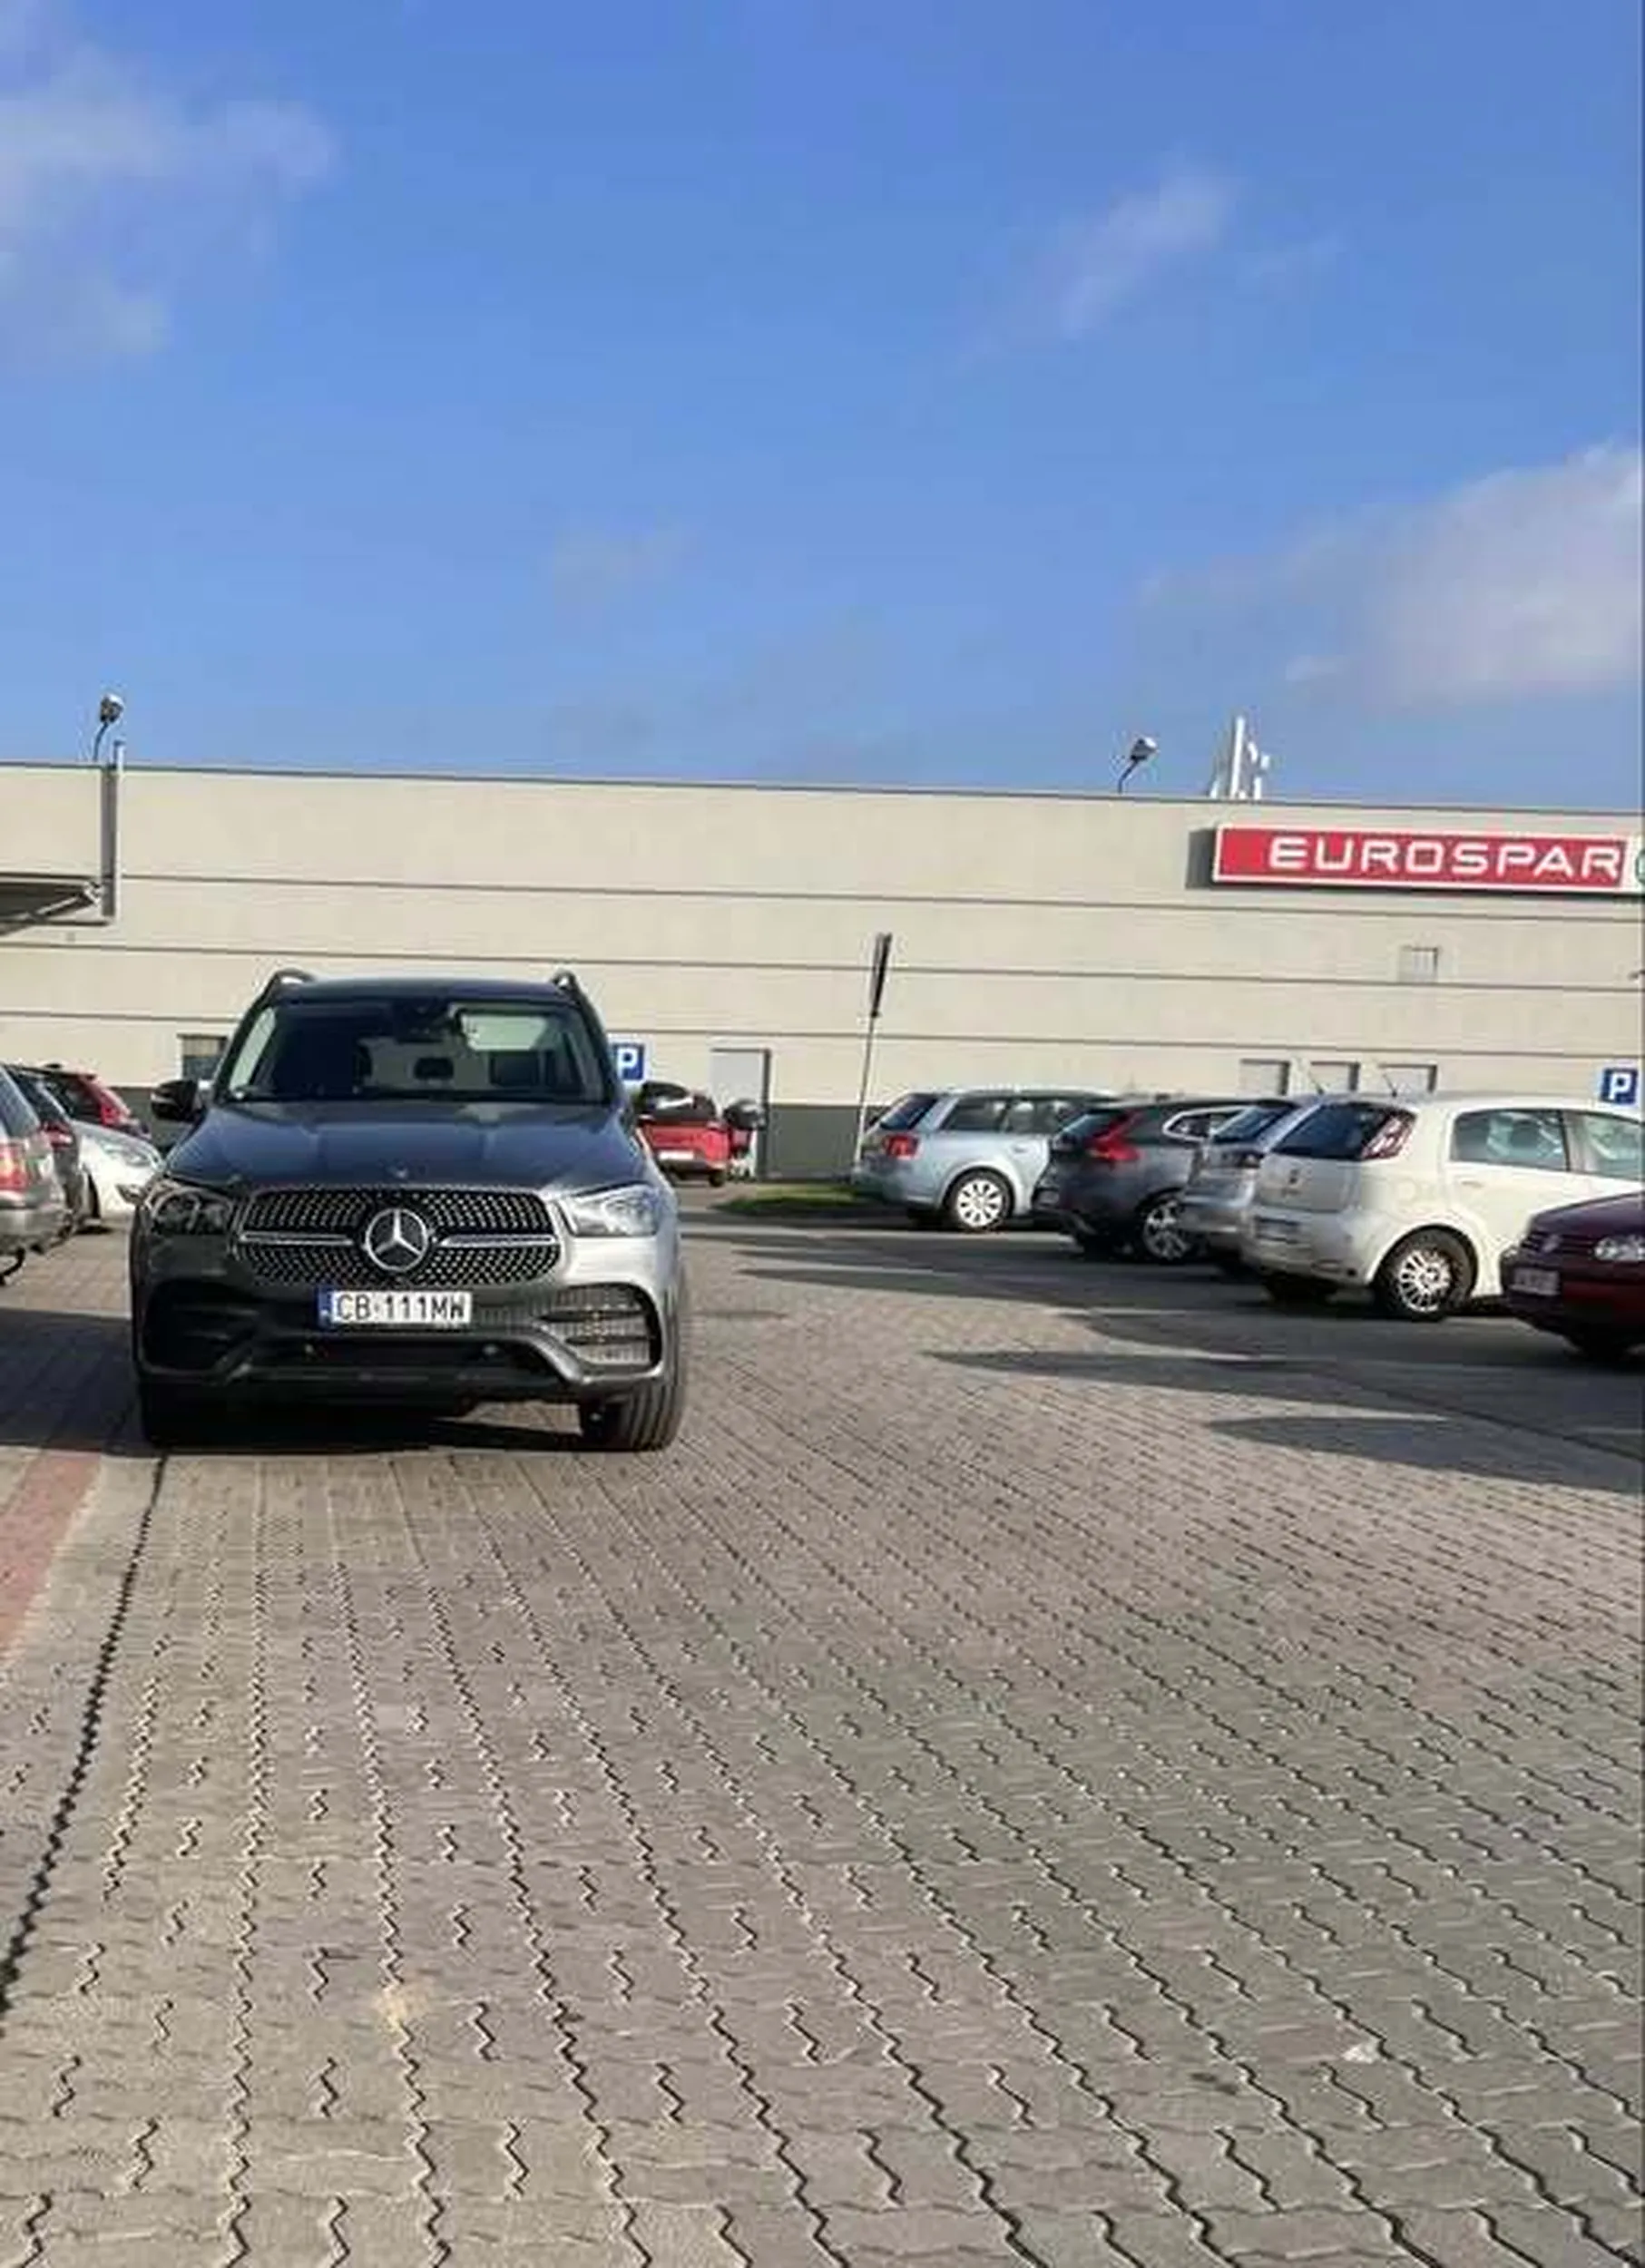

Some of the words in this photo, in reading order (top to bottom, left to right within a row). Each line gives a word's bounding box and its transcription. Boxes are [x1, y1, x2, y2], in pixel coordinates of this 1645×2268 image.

[1269, 837, 1621, 878] EUROSPAR
[617, 1047, 639, 1080] P
[1609, 1072, 1631, 1100] P
